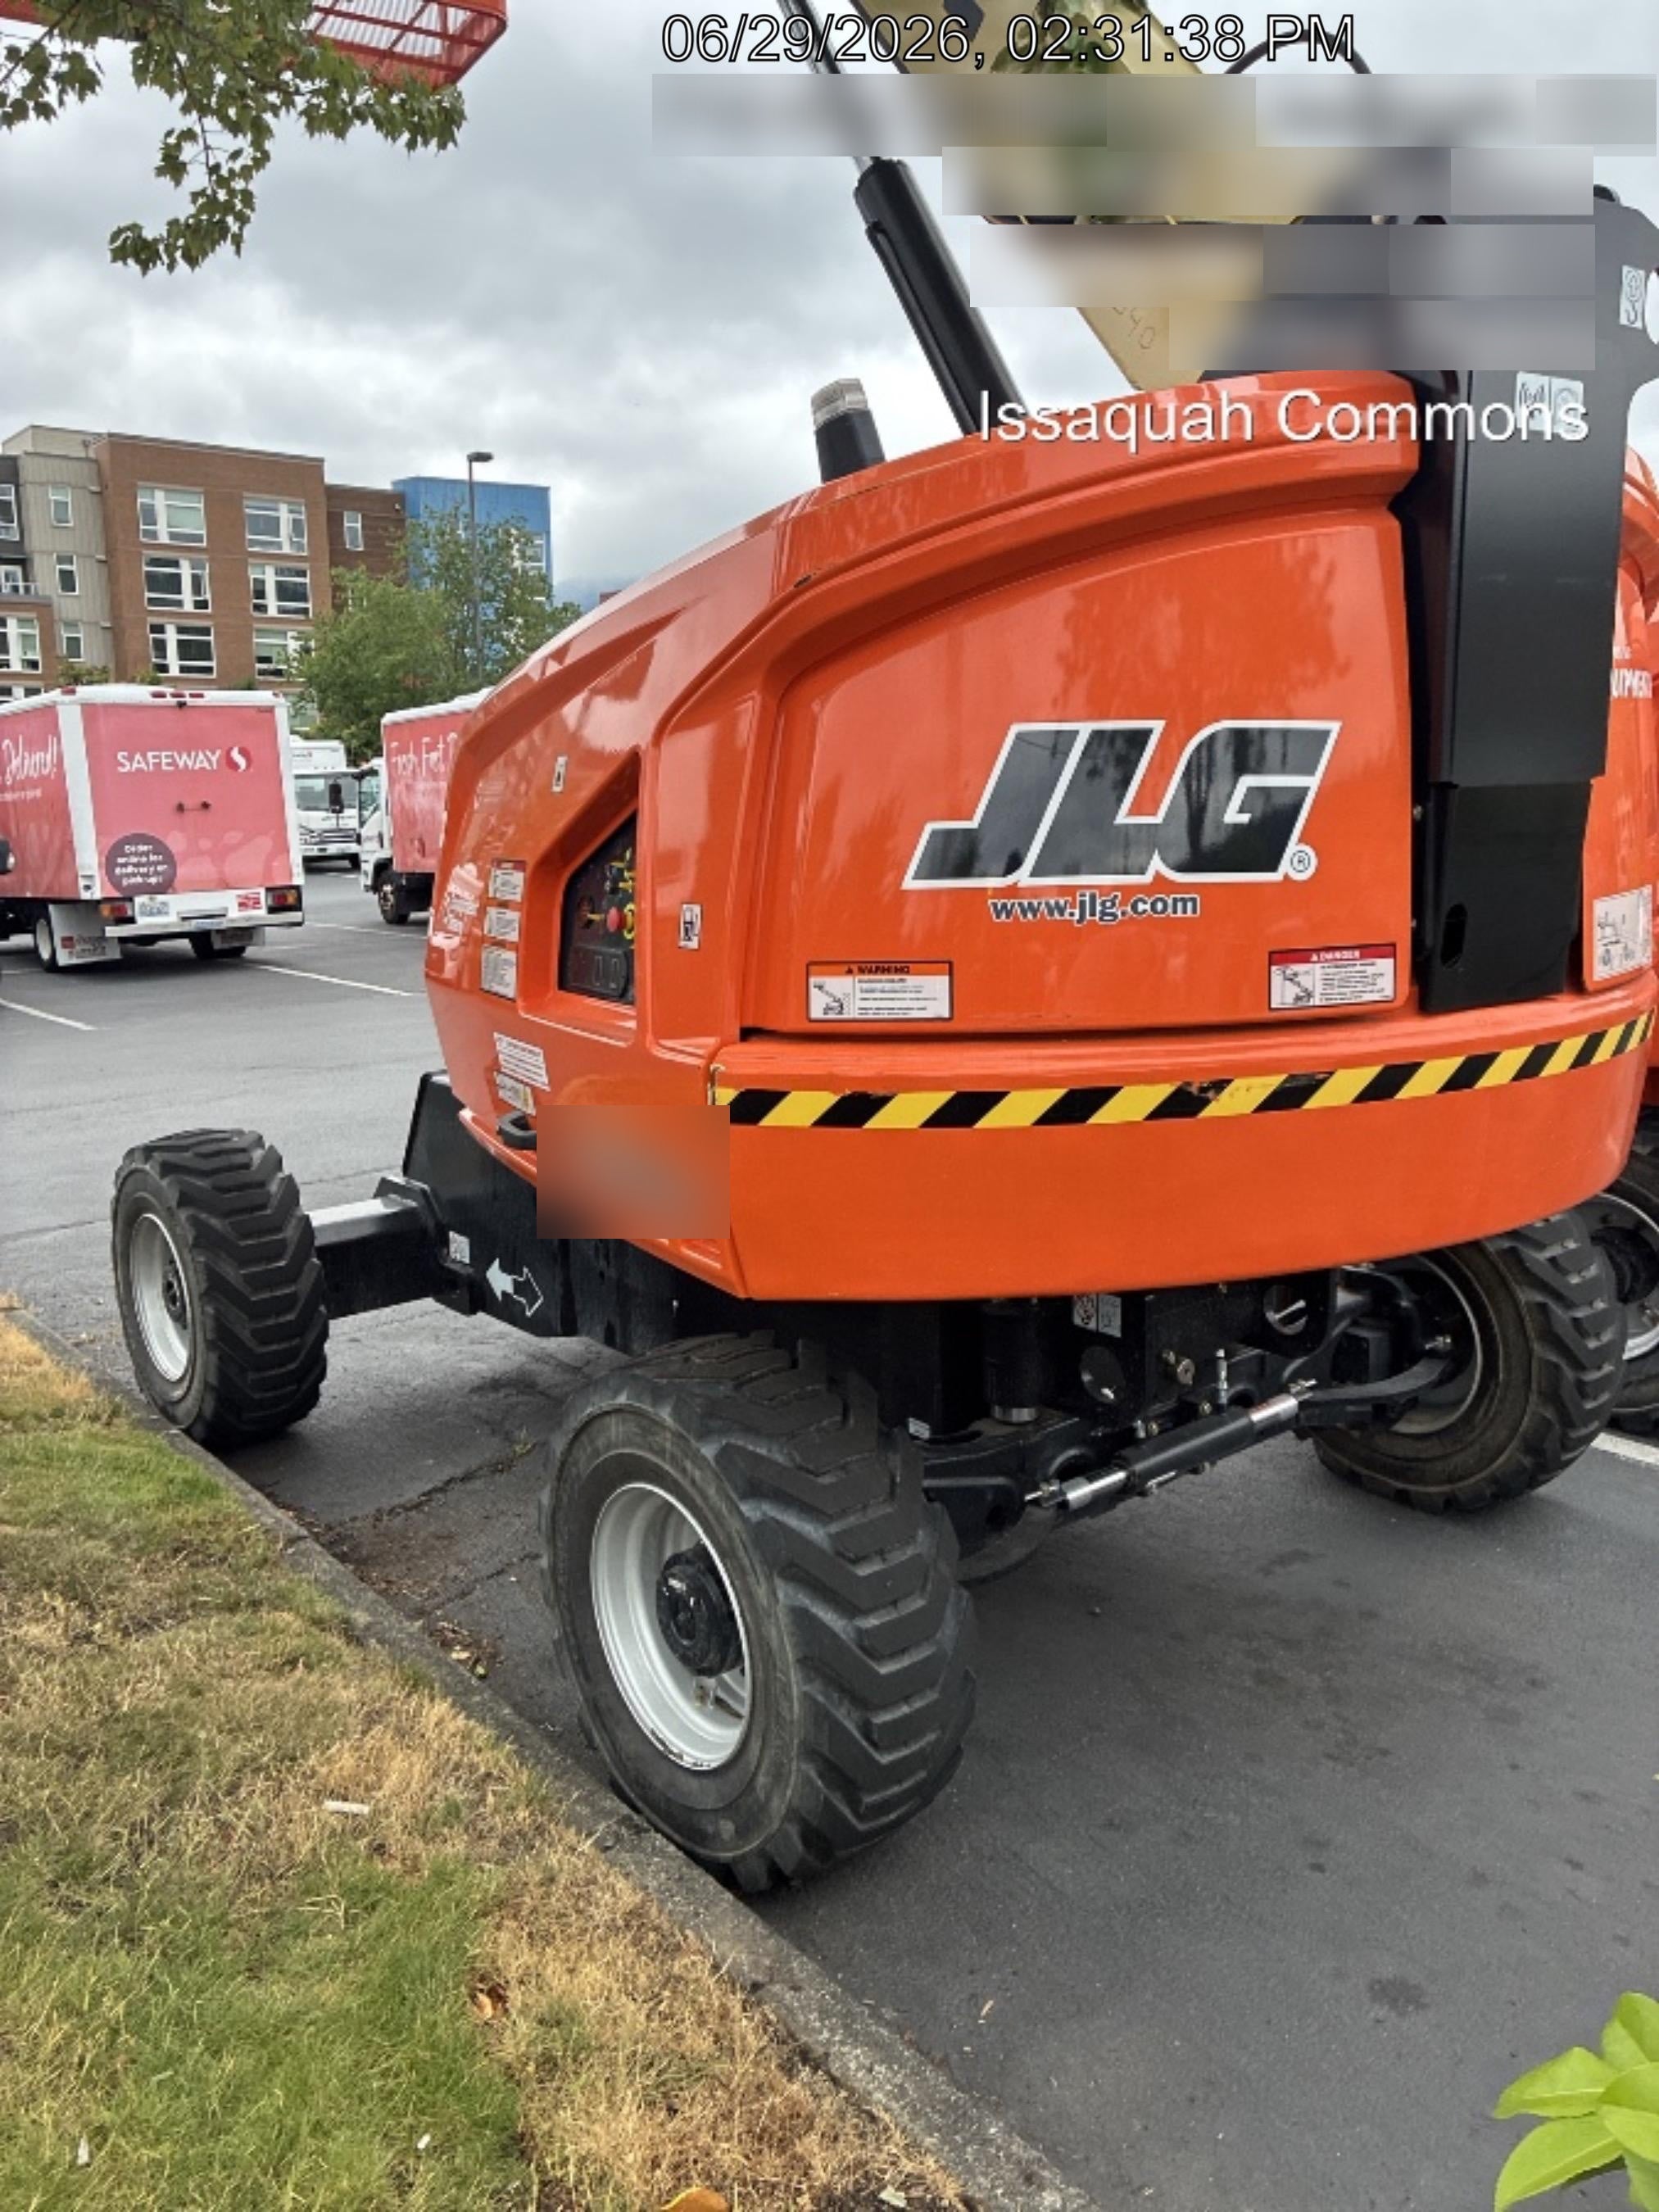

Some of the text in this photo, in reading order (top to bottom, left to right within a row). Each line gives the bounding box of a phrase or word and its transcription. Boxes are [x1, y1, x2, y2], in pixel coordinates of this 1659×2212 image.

[116, 749, 222, 773] SAFEWAY
[901, 719, 1341, 889] JLG
[990, 893, 1200, 923] www.jlg.com
[1319, 950, 1361, 961] DANGER
[857, 965, 910, 974] WARNING
